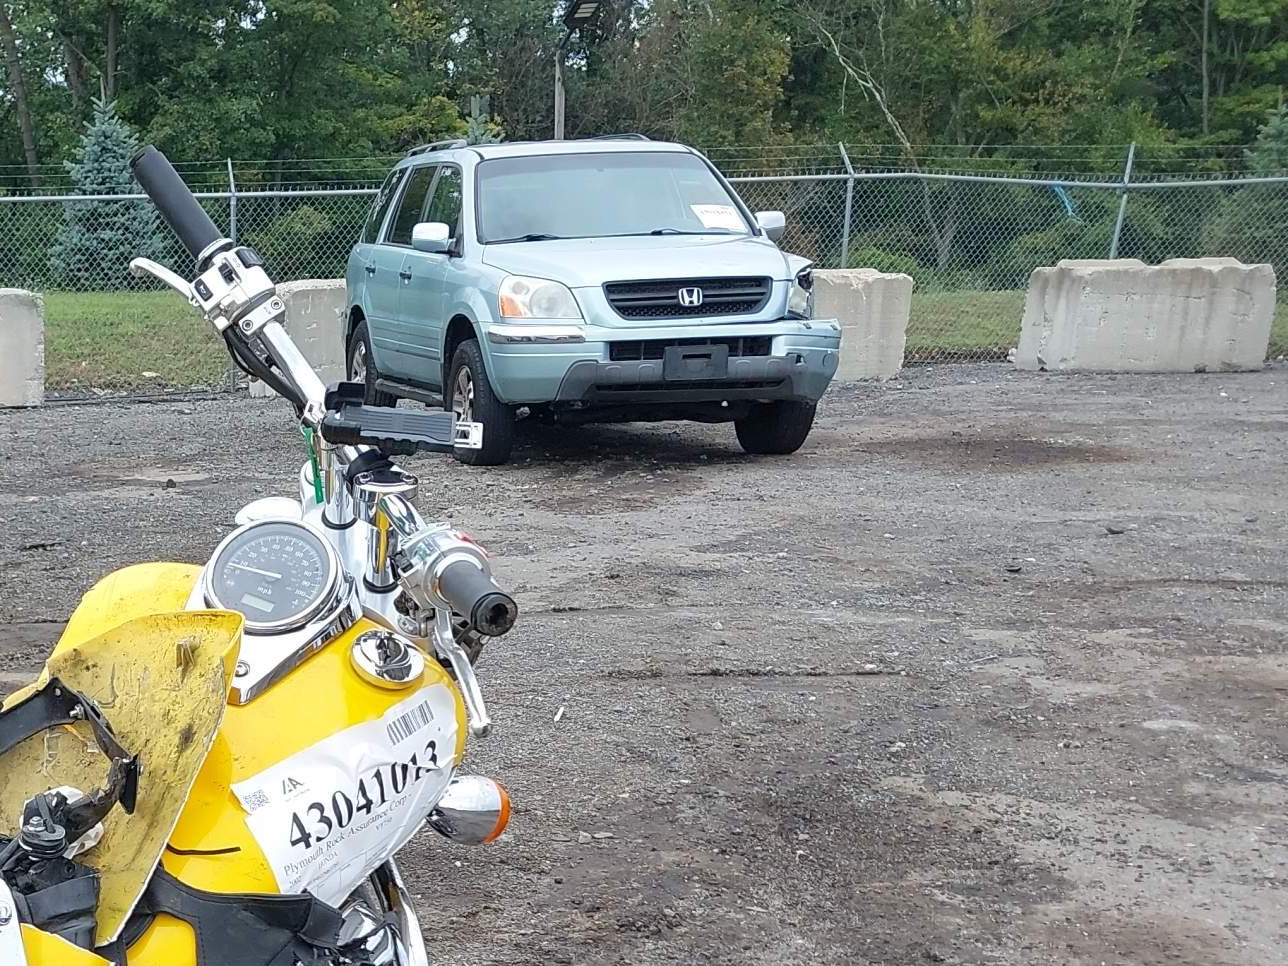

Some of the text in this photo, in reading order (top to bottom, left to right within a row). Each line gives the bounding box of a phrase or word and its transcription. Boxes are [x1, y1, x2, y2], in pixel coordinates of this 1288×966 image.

[283, 845, 324, 877] Plymouth
[325, 831, 345, 851] Rock
[348, 808, 390, 837] Assurance
